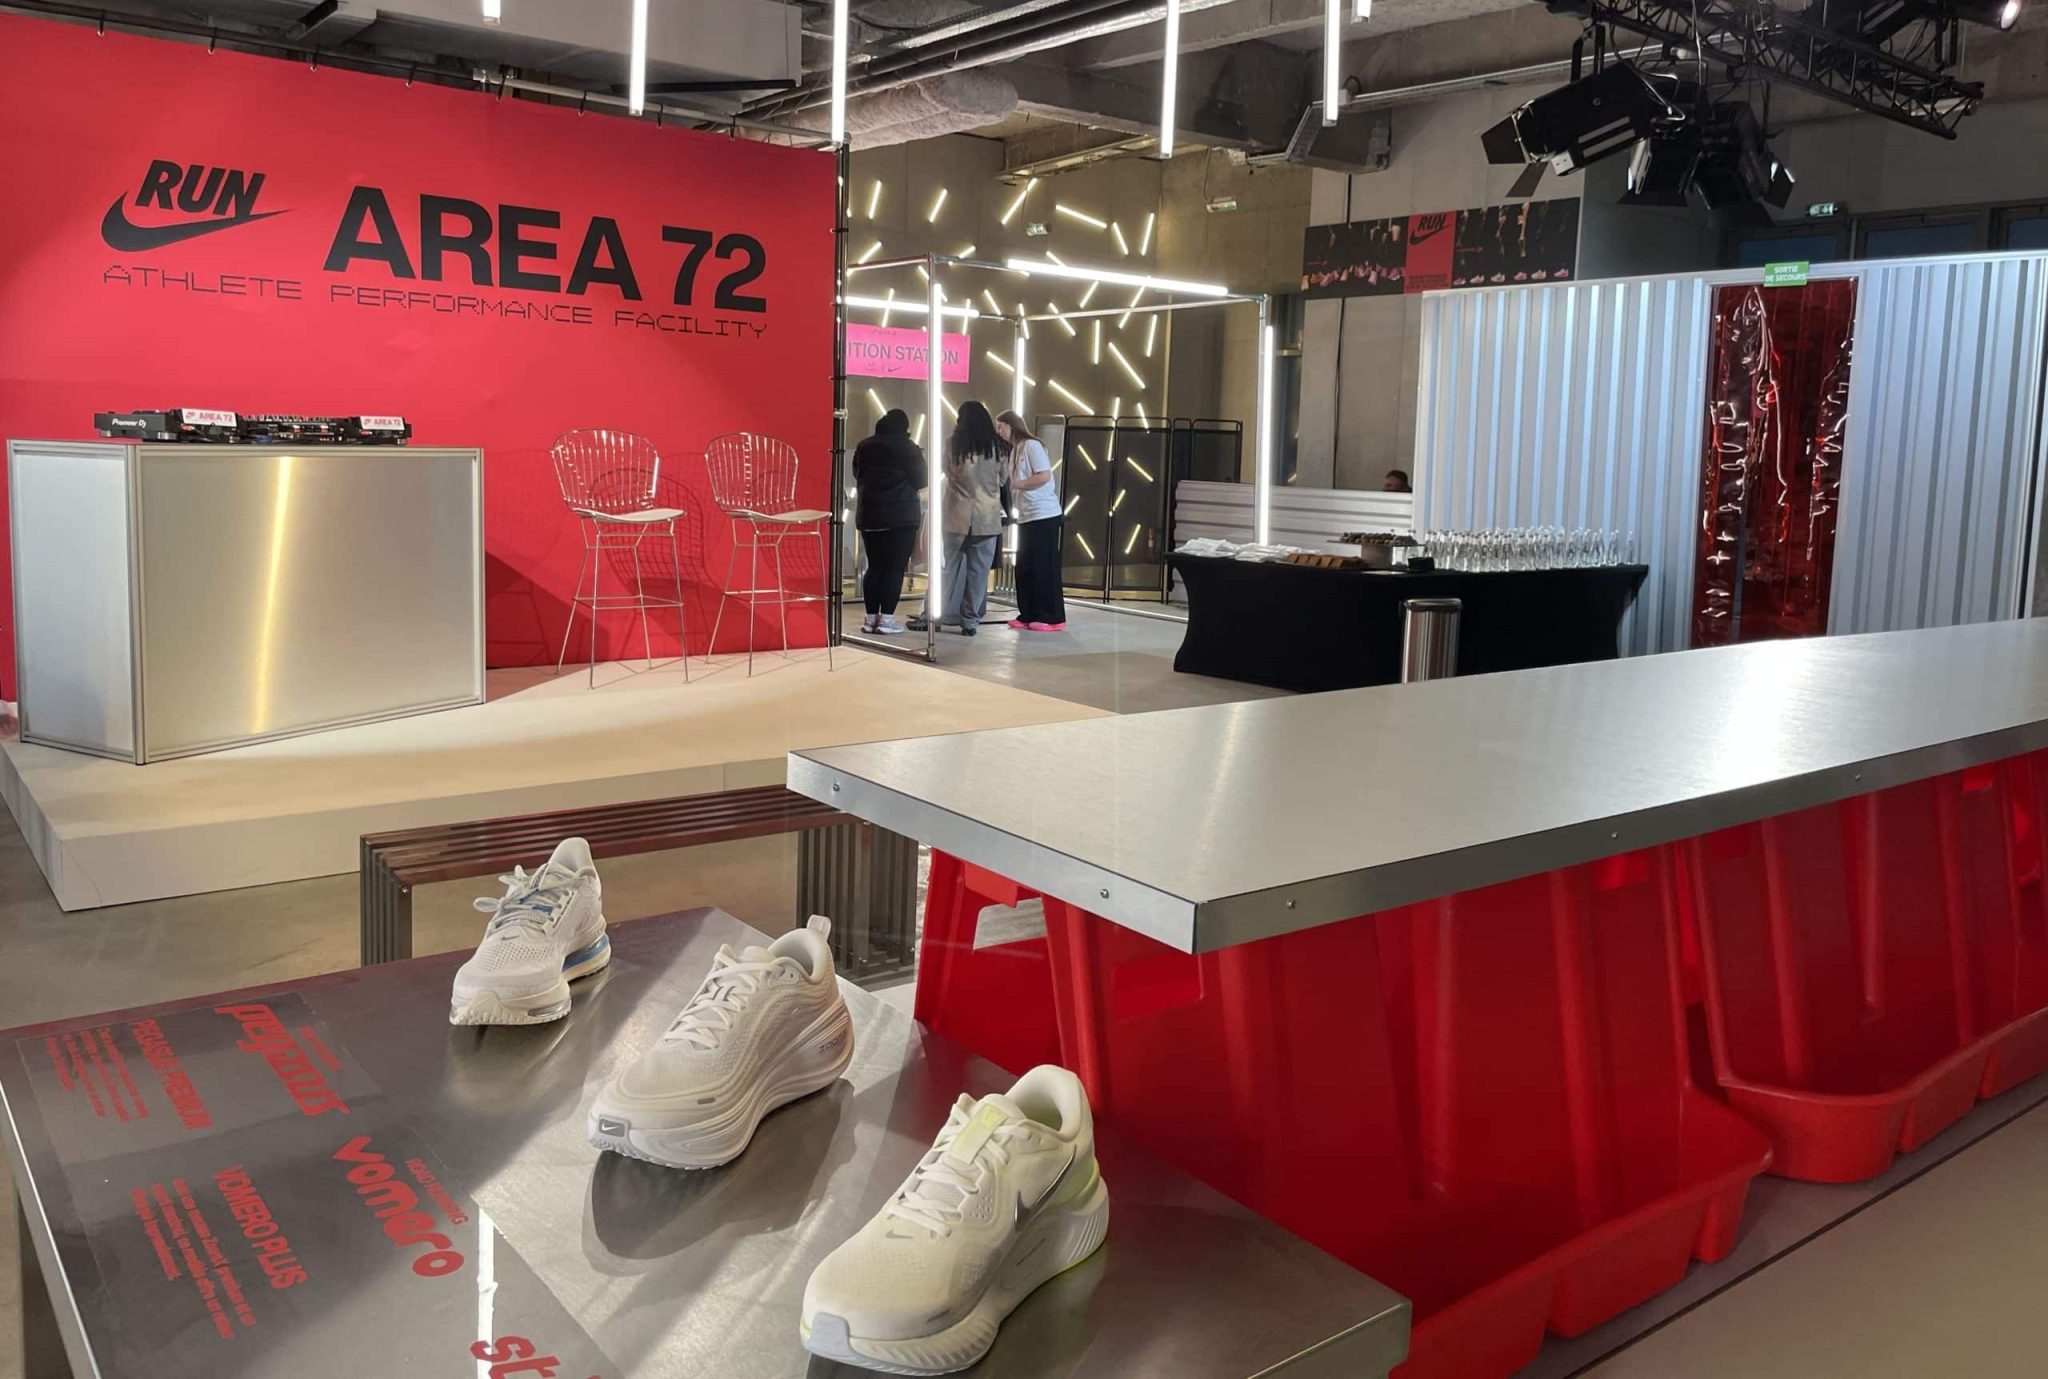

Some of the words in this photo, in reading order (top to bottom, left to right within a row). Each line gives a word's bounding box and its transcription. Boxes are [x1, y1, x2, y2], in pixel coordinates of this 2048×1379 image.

[134, 159, 267, 217] RUN
[1417, 213, 1447, 232] RUN
[322, 185, 642, 302] AREA
[661, 224, 767, 313] 72
[1765, 274, 1773, 282] DE
[1775, 273, 1806, 282] SECOURS
[1774, 265, 1799, 274] SORTIE
[103, 264, 302, 300] ATHLETE
[330, 284, 592, 324] PERFORMANCE
[614, 310, 768, 339] FACILITY
[848, 341, 891, 360] ITION
[896, 345, 959, 366] STATON
[199, 412, 221, 421] AREA
[222, 413, 233, 422] 72
[374, 418, 393, 426] AREA
[332, 1135, 465, 1277] vomero
[213, 1163, 280, 1239] VOMERO
[251, 1235, 308, 1289] PLUS
